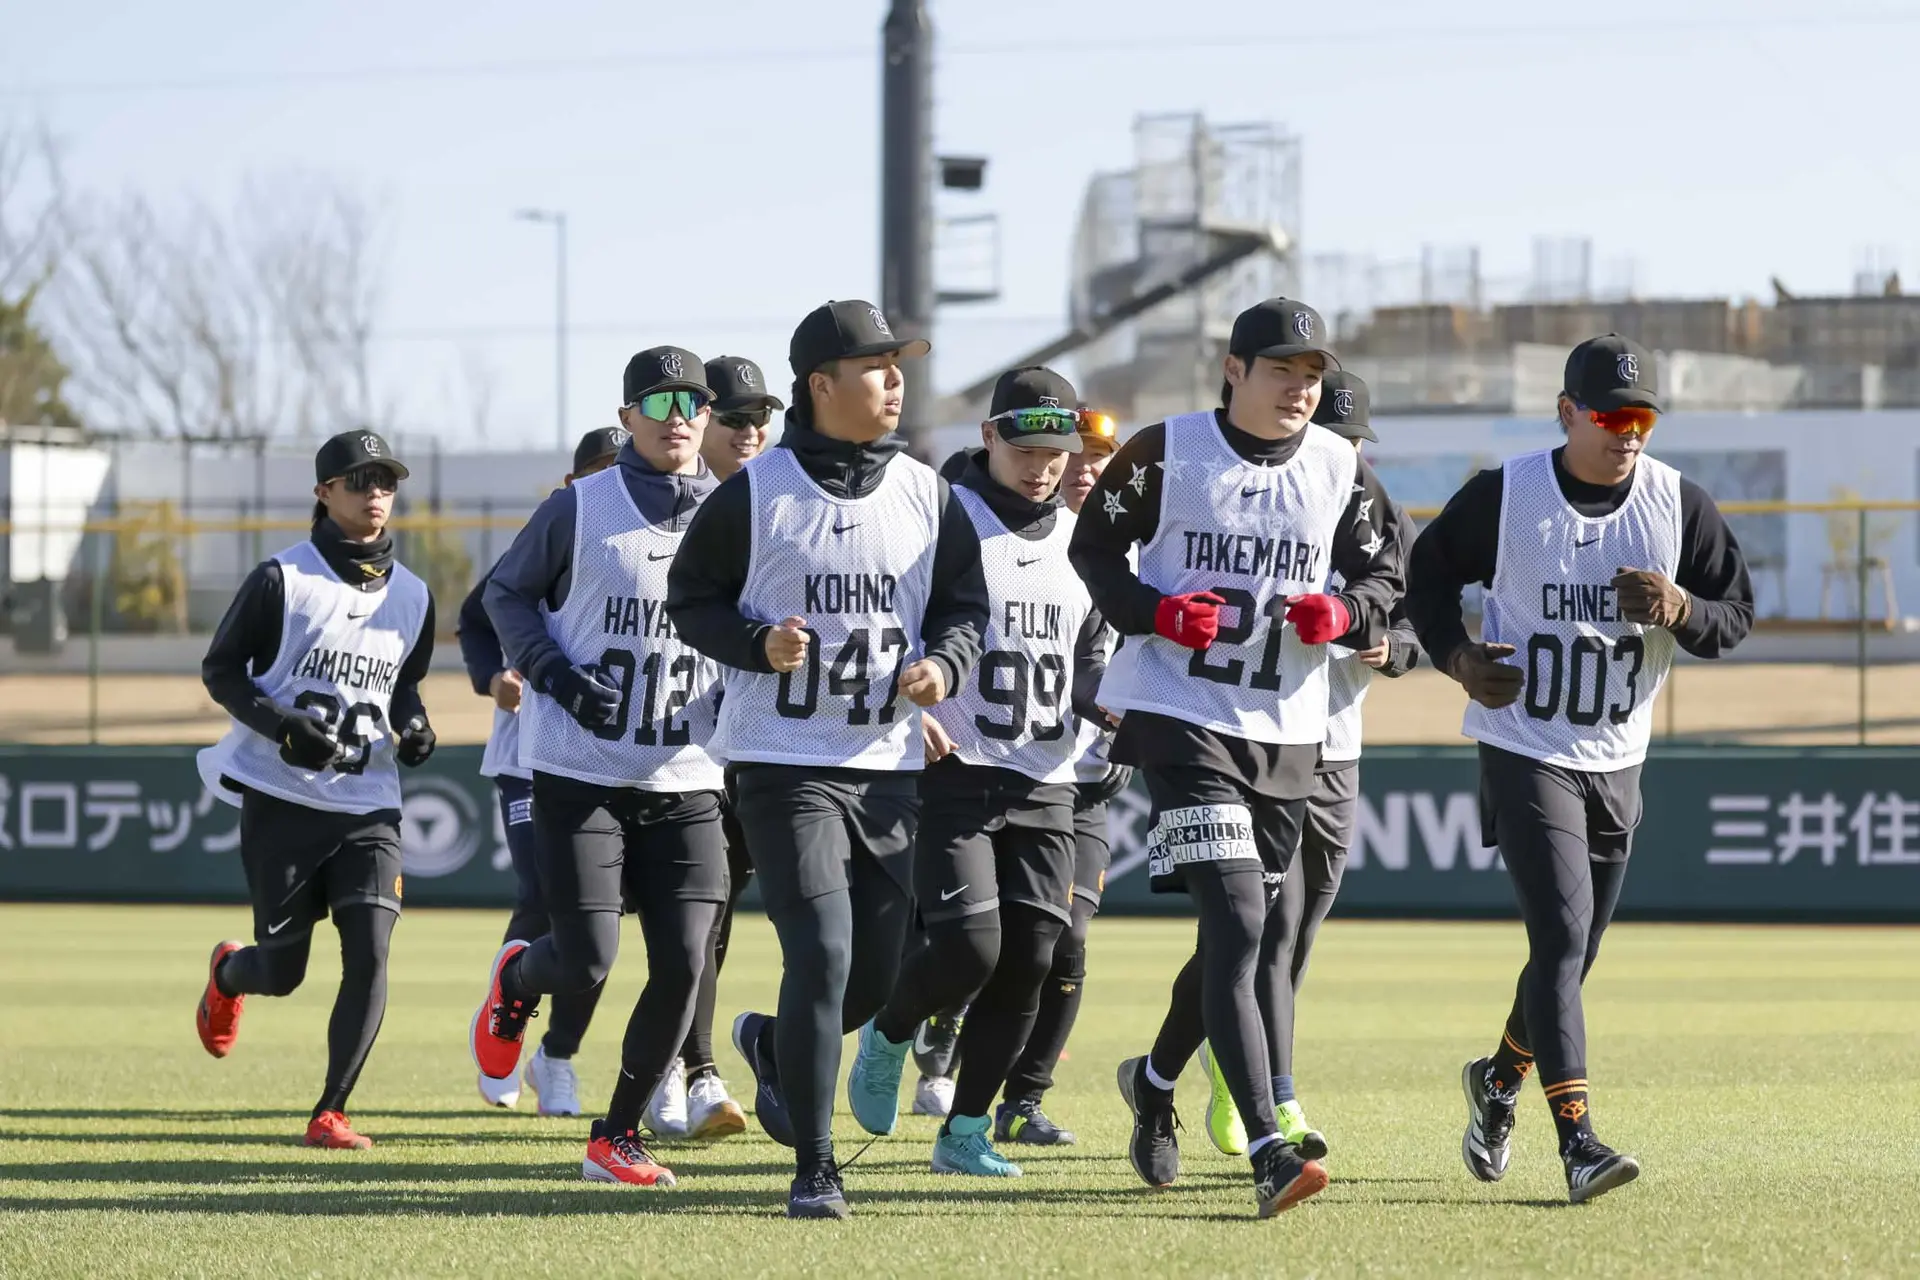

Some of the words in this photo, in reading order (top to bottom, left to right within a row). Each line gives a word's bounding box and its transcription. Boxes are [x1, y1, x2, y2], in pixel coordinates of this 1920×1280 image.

[805, 573, 896, 614] KOHNO
[1183, 531, 1320, 583] TAKEMARU
[604, 596, 678, 640] HAYA
[1188, 586, 1288, 692] 21
[1542, 583, 1622, 622] CHINE
[589, 648, 695, 746] 012
[776, 627, 908, 725] 047
[975, 650, 1067, 741] 99
[1524, 633, 1644, 726] 003
[1705, 792, 1920, 866] 三井住
